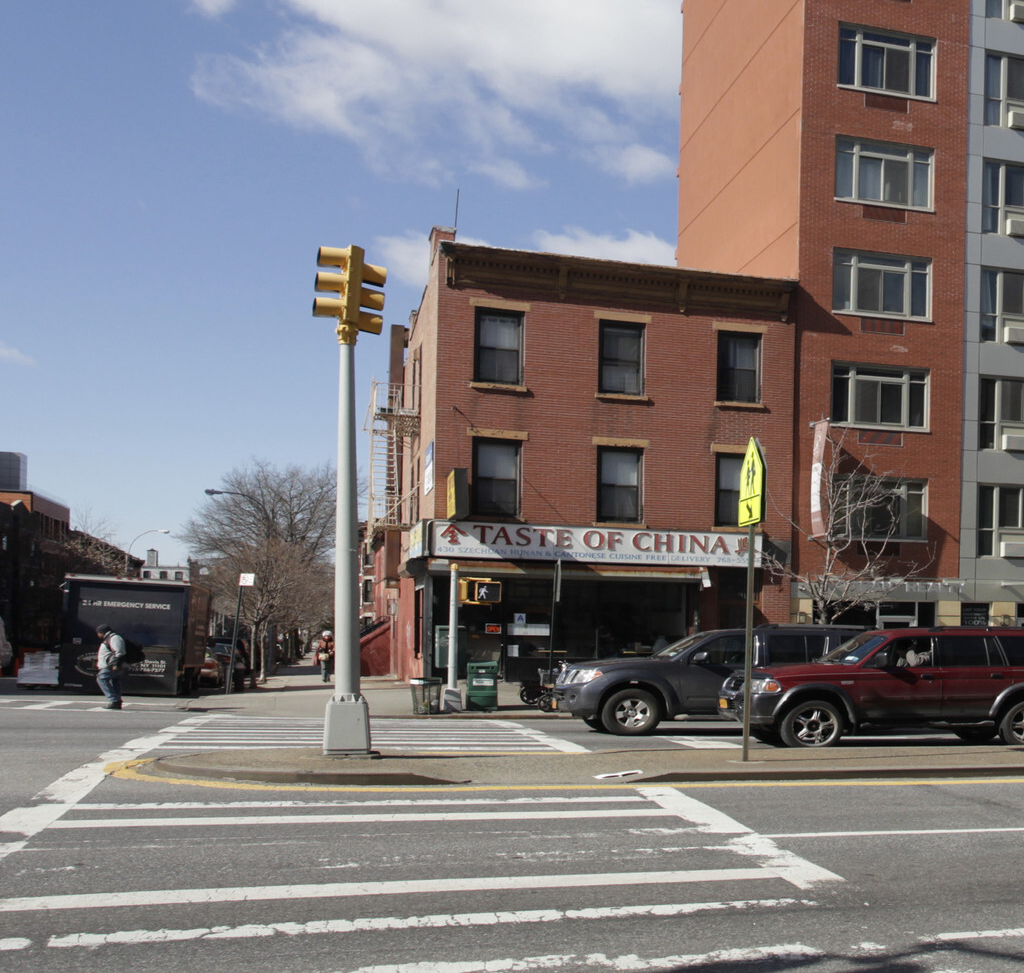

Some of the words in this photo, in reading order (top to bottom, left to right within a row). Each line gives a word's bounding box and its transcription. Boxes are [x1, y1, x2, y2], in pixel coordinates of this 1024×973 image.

[473, 525, 574, 549] TASTE
[583, 530, 624, 551] OF
[632, 532, 731, 555] CHINA
[458, 546, 507, 556] SZECHUAN
[510, 548, 542, 557] HUNAN
[554, 550, 606, 560] CANTONESE
[609, 552, 643, 561] CUISINE
[646, 554, 667, 562] FREE
[671, 555, 711, 563] DELIVERY
[904, 581, 966, 593] REALTY
[104, 600, 144, 608] EMERGENCY
[145, 602, 171, 610] SERVICE
